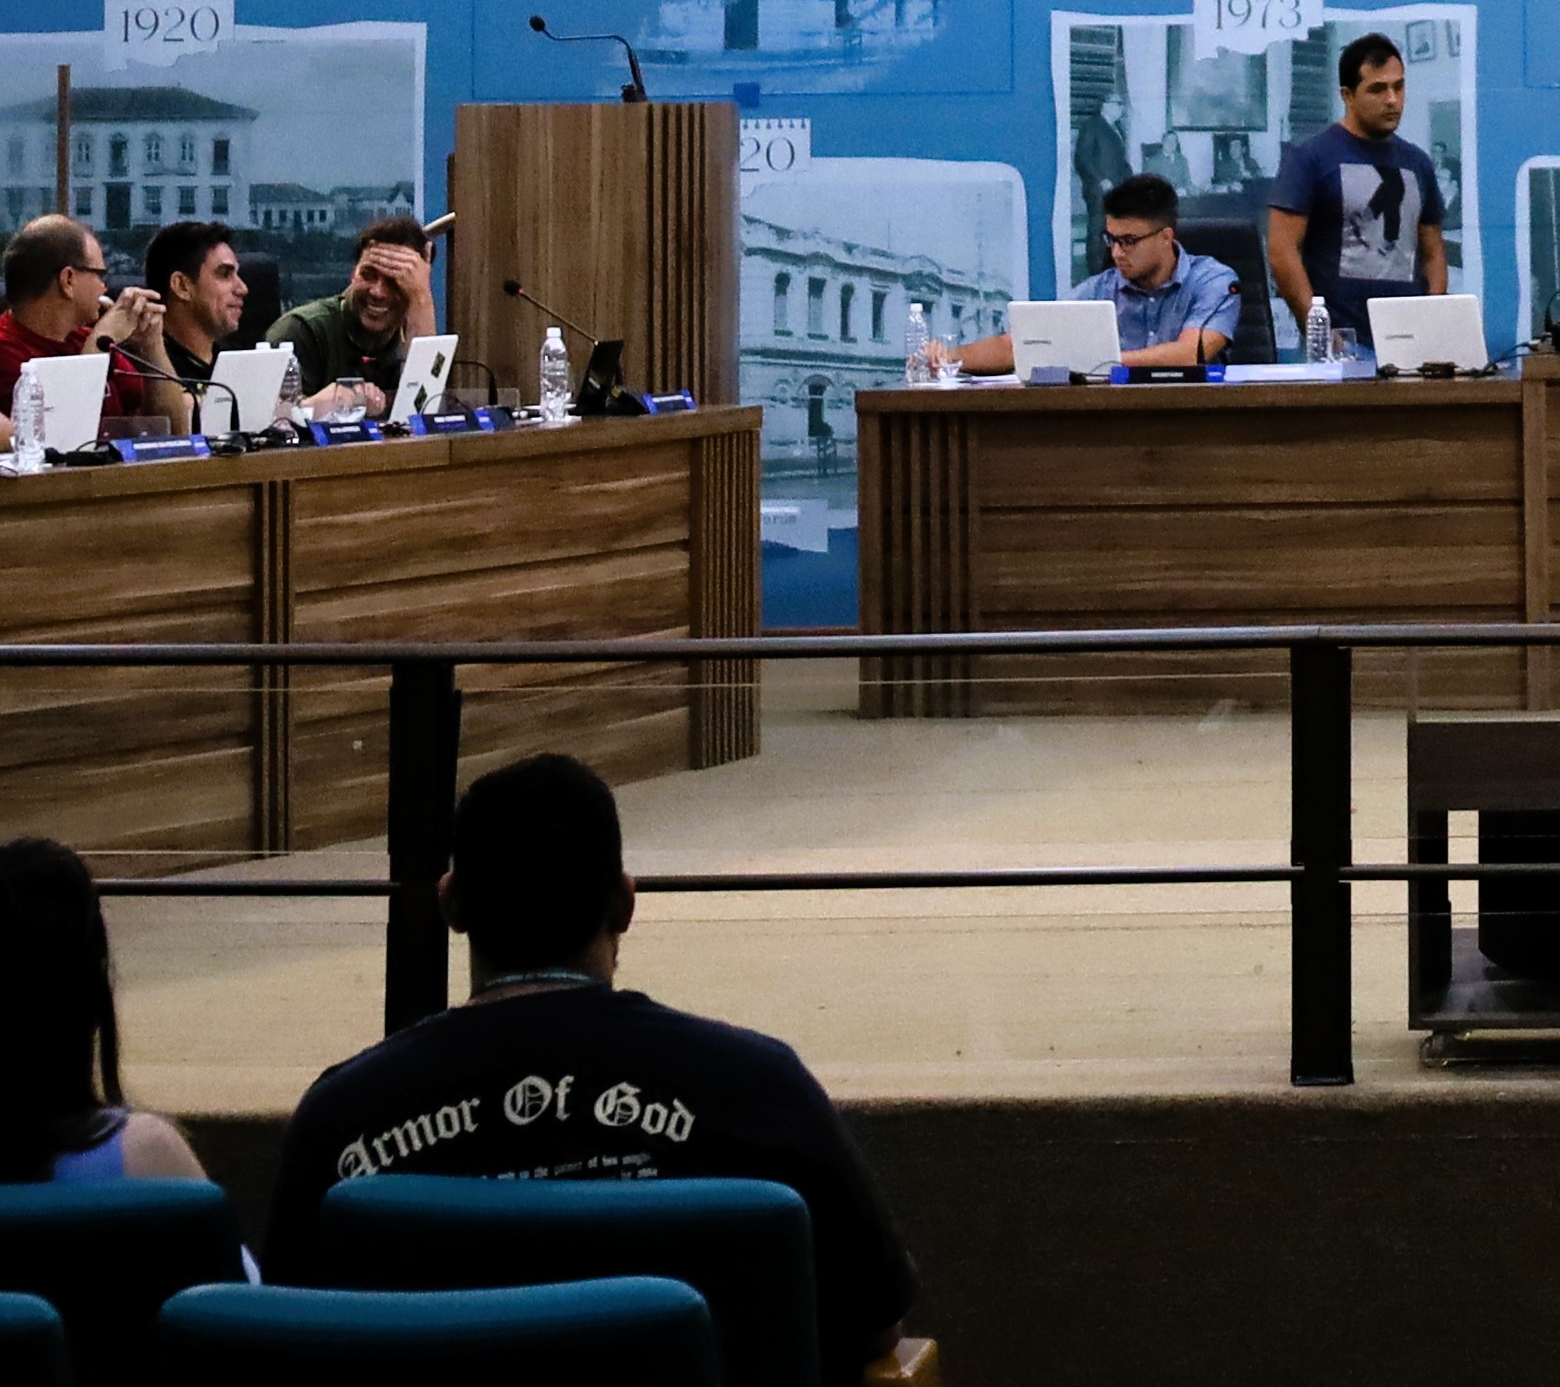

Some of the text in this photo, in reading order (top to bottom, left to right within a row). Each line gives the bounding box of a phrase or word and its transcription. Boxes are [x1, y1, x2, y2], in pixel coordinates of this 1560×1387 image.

[122, 7, 220, 43] 1920
[337, 1074, 695, 1178] Armor Of God
